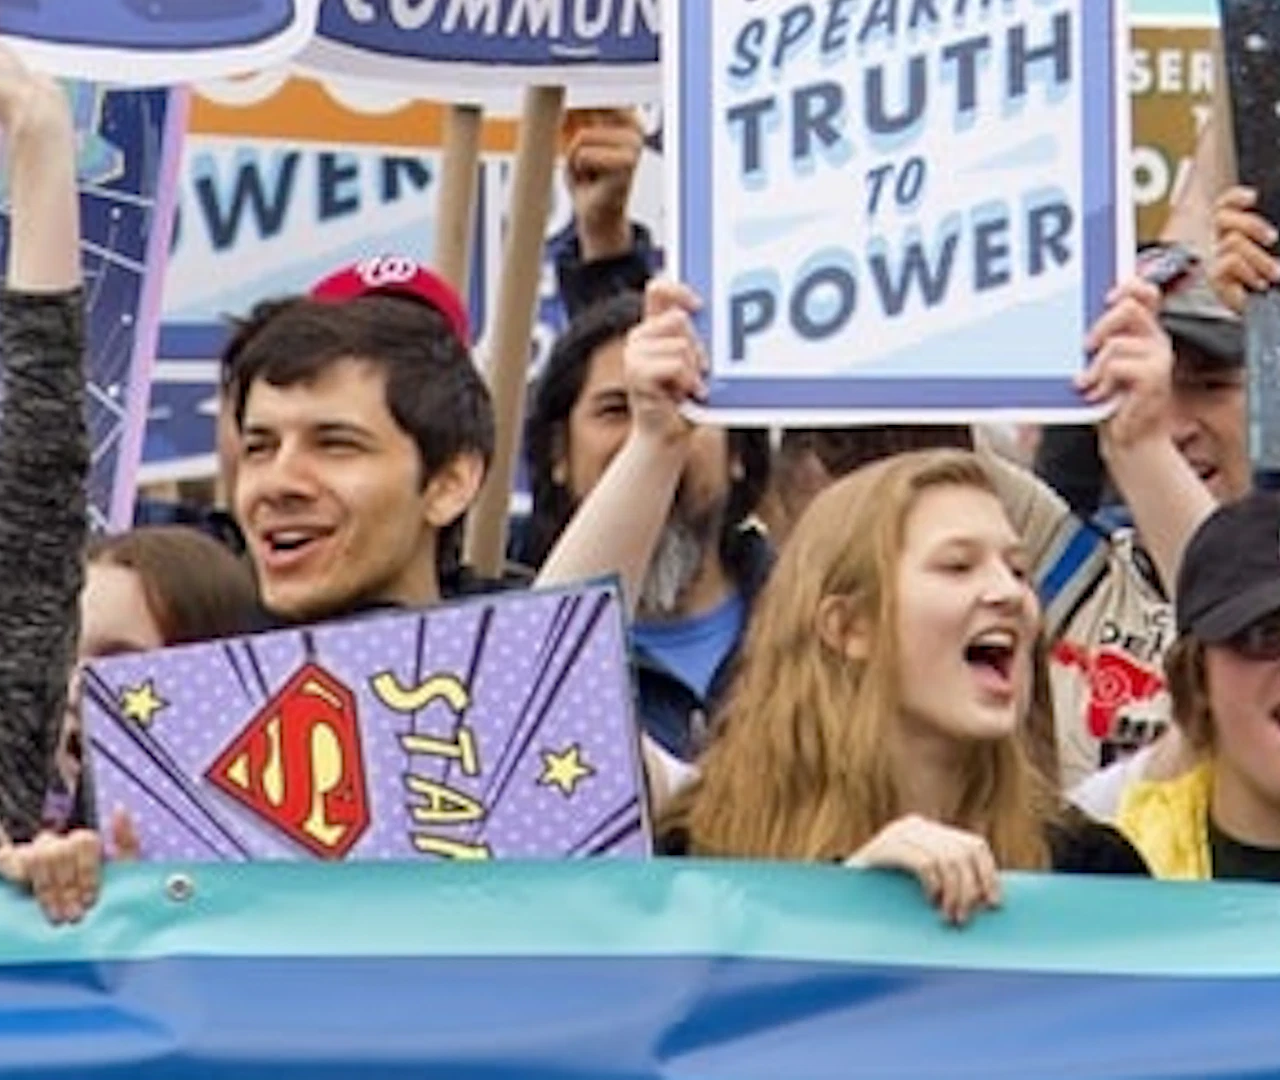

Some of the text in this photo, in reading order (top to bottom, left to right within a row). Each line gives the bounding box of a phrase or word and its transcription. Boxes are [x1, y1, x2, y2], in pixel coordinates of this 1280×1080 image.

[727, 10, 1073, 177] TRUTH
[865, 157, 927, 215] TO
[729, 204, 1074, 363] POWER
